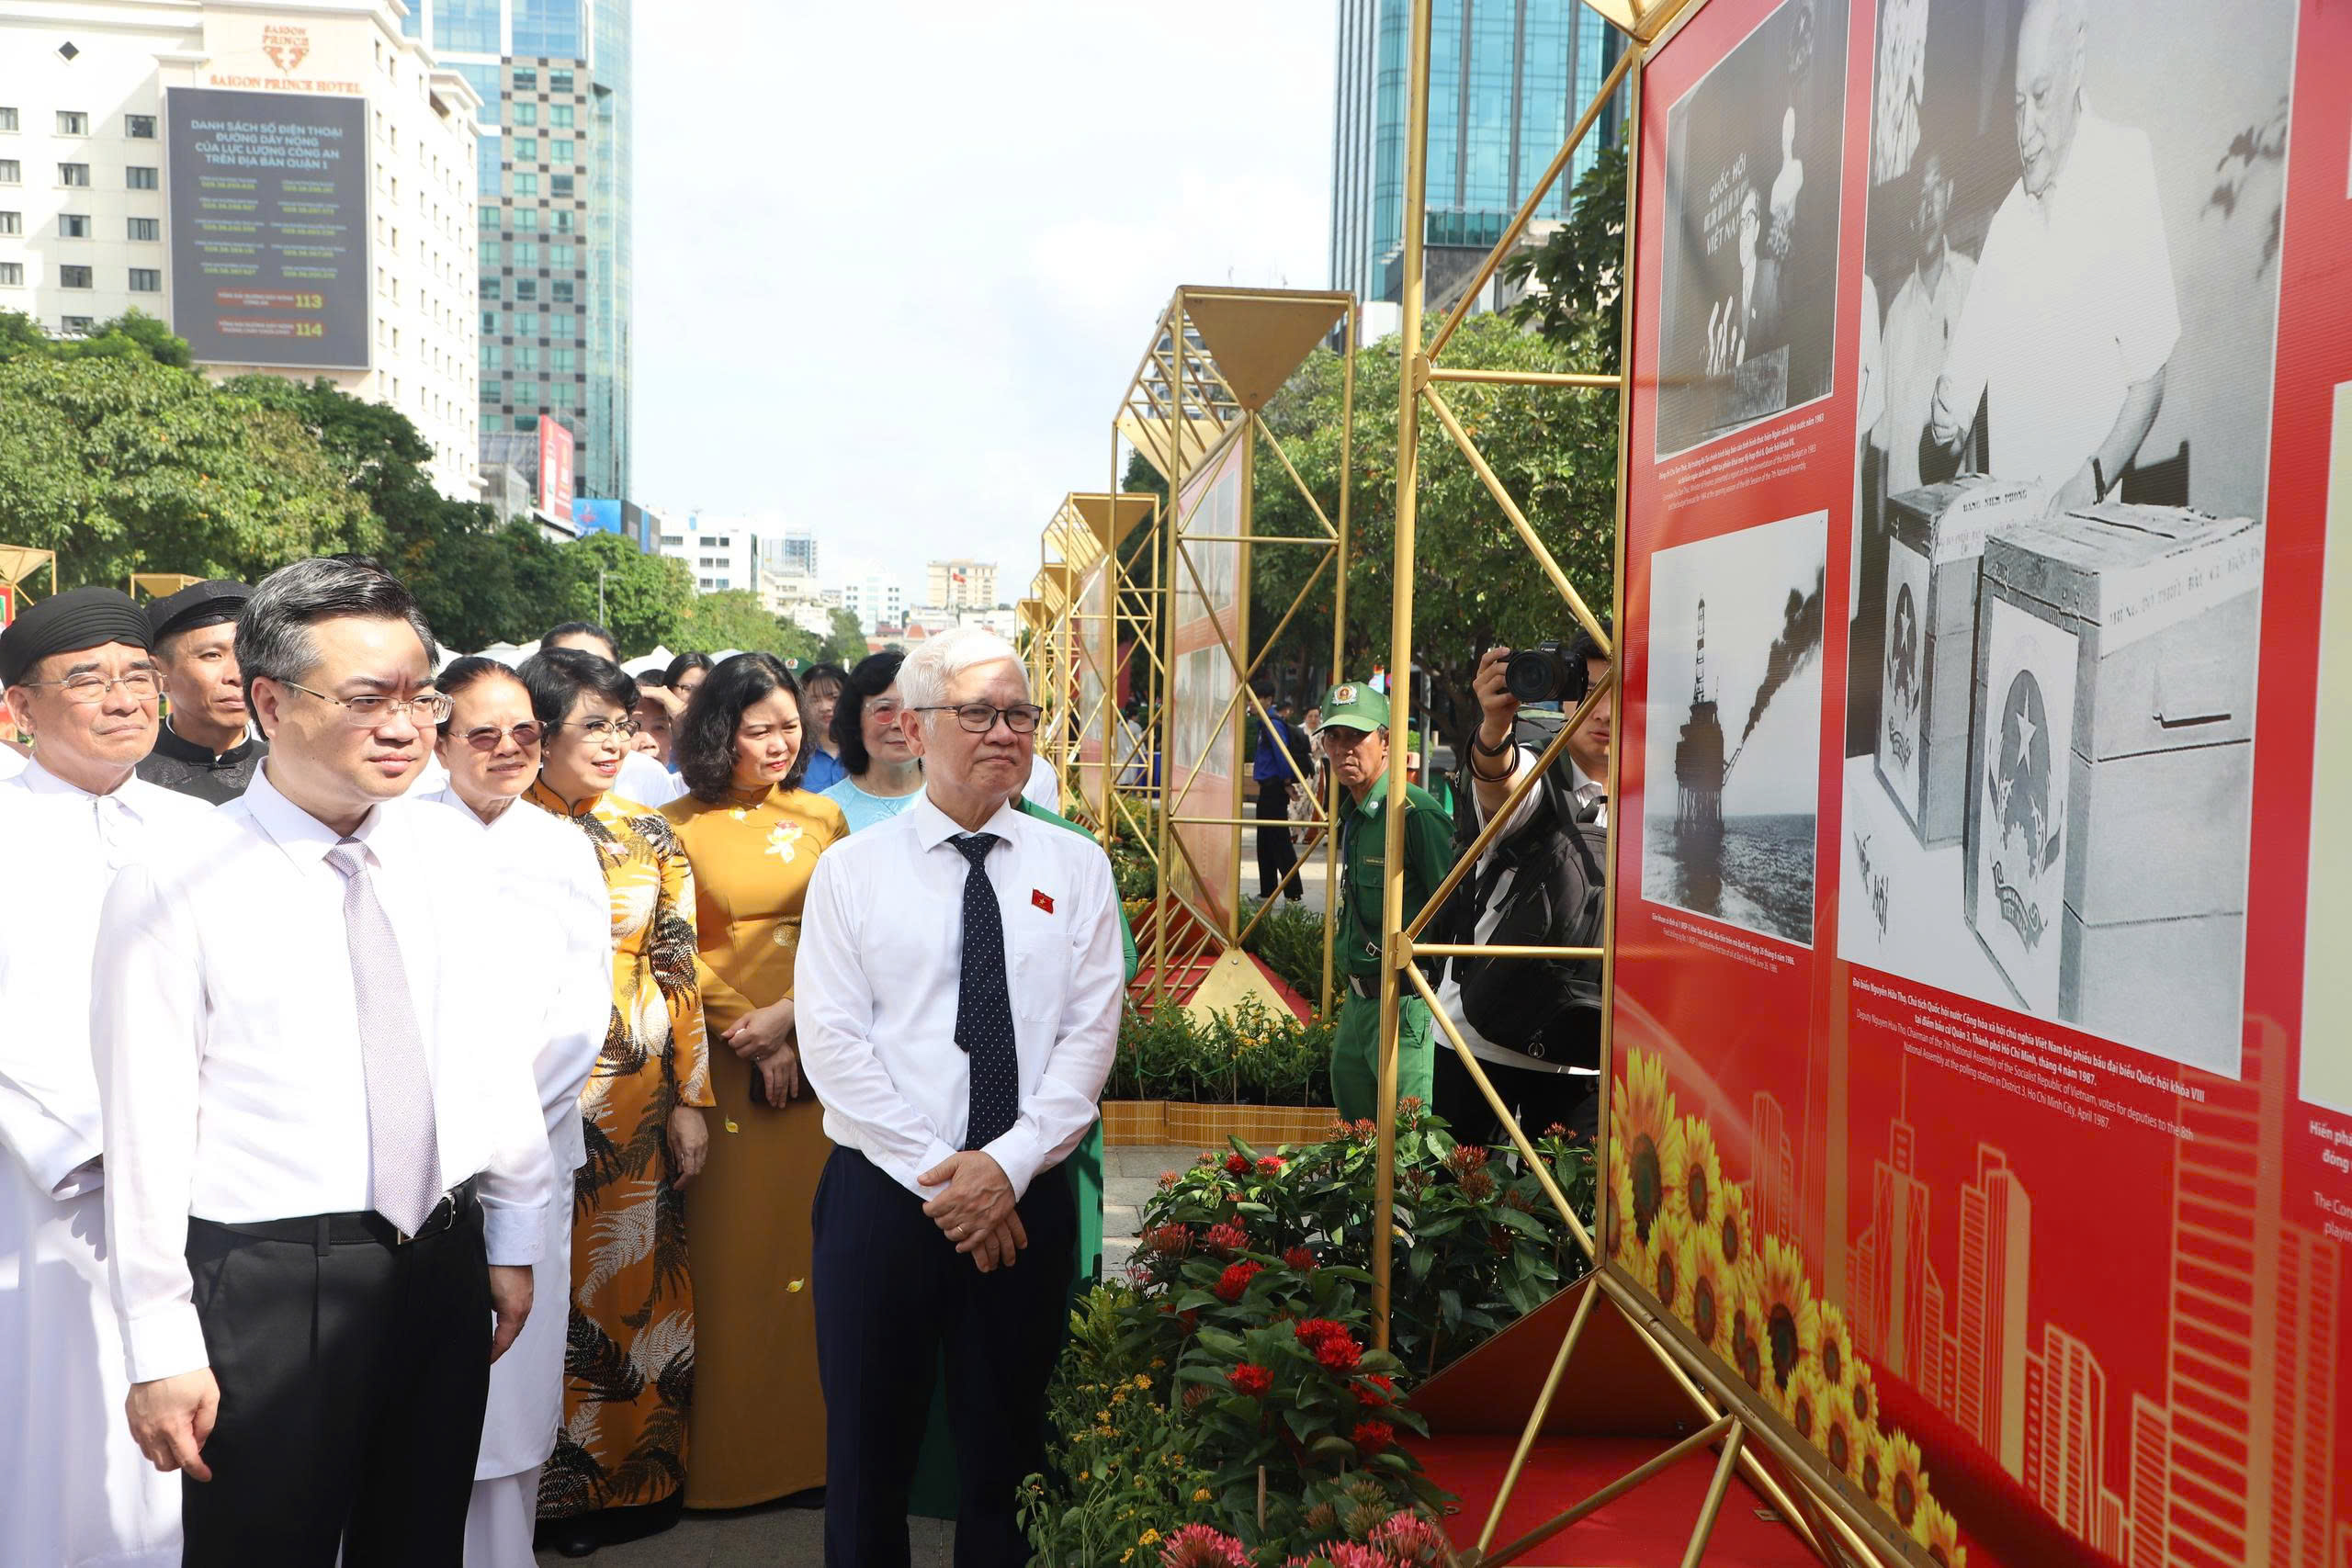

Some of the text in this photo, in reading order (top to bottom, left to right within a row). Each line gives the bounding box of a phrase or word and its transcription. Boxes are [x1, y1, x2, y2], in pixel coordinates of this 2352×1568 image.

[263, 35, 309, 45] PRINCE
[210, 74, 361, 93] SAIGON PRINCE HOTEL
[191, 119, 343, 140] DANH SÁCH SỐ ĐIỆN THOẠI
[205, 153, 235, 165] TRÊN
[287, 158, 319, 170] QUẬN
[288, 146, 320, 158] CÔNG
[322, 150, 339, 159] AN
[296, 294, 322, 309] 113
[296, 322, 322, 337] 114
[1815, 412, 1824, 423] 1983
[1922, 1016, 1934, 1028] điểm
[1935, 1020, 1944, 1032] bầu
[1951, 1027, 1966, 1042] Quận
[1972, 1033, 1989, 1047] Thành
[1989, 1038, 2001, 1054] phố
[2001, 1043, 2010, 1055] Hồ
[2010, 1046, 2020, 1058] Chí
[2020, 1051, 2038, 1066] Minh,
[2039, 1056, 2057, 1074] tháng
[2063, 1066, 2077, 1078] năm
[2078, 1070, 2097, 1086] 1987.
[1927, 1000, 1940, 1015] Quốc
[1940, 1006, 1950, 1019] hội
[1962, 1012, 1977, 1028] Cộng
[1977, 1017, 1987, 1029] hòa
[1996, 1023, 2006, 1038] hội
[2006, 1027, 2017, 1038] chủ
[2017, 1031, 2034, 1047] nghĩa
[2035, 1036, 2047, 1052] Việt
[2048, 1041, 2062, 1054] Nam
[2064, 1045, 2074, 1057] bỏ
[2074, 1047, 2092, 1066] phiếu
[2093, 1054, 2106, 1068] bầu
[2107, 1060, 2119, 1077] đại
[2120, 1063, 2135, 1078] biểu
[2136, 1067, 2156, 1088] Quốc
[2157, 1076, 2169, 1093] hội
[2170, 1080, 2190, 1098] khóa
[2191, 1088, 2205, 1102] VIII
[1856, 1009, 1871, 1023] Deputy
[1871, 1014, 1887, 1029] Nguyen
[1906, 1027, 1928, 1042] Chairman
[1943, 1040, 1951, 1051] 7th
[1951, 1043, 1973, 1058] National
[1973, 1051, 1996, 1069] Assembly
[2004, 1062, 2013, 1073] the
[2014, 1065, 2037, 1082] Socialist
[2037, 1074, 2062, 1093] Republic
[2070, 1086, 2098, 1106] Vietnam,
[2098, 1098, 2116, 1111] votes
[2117, 1102, 2127, 1115] for
[2128, 1107, 2157, 1129] deputies
[2167, 1121, 2179, 1135] the
[2180, 1125, 2194, 1141] 8th
[1904, 1042, 1923, 1055] National
[1923, 1049, 1944, 1066] Assembly
[1960, 1063, 1977, 1079] polling
[1977, 1070, 1996, 1084] station
[2002, 1078, 2021, 1094] District
[2028, 1089, 2036, 1100] Ho
[2037, 1092, 2046, 1104] Chi
[2047, 1096, 2062, 1110] Minh
[2077, 1108, 2093, 1124] April
[2094, 1113, 2110, 1129] 1987.
[2310, 1121, 2333, 1140] Hiến
[2323, 1149, 2349, 1173] đóng
[2313, 1190, 2331, 1211] The
